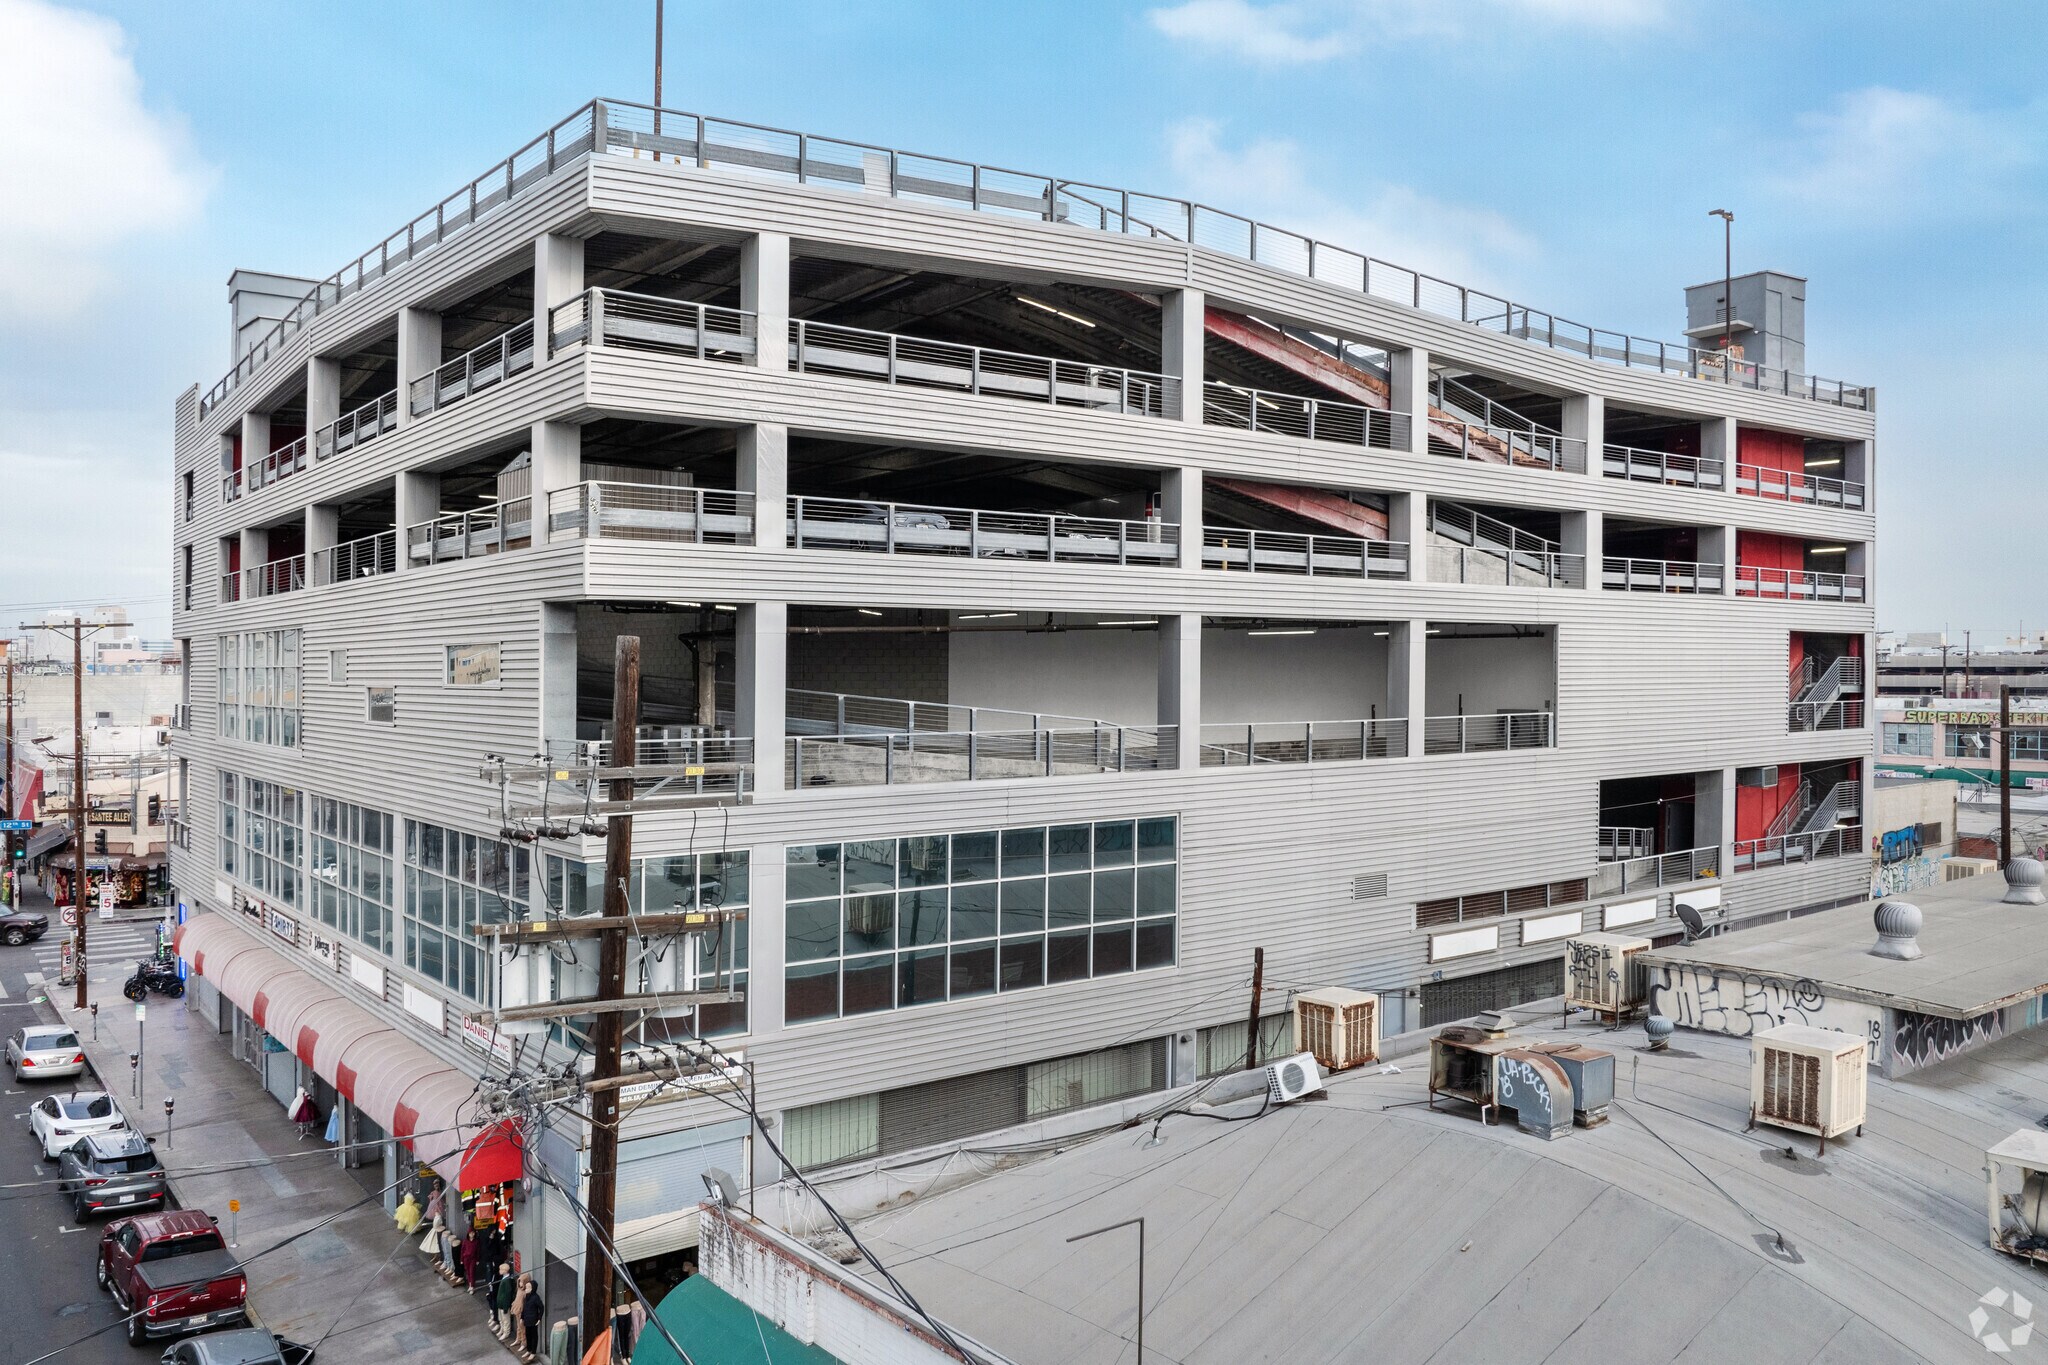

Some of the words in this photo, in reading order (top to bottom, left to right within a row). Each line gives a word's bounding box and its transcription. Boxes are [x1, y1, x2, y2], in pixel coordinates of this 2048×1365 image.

[113, 812, 131, 822] ALLEY
[103, 897, 112, 908] 5
[1867, 1019, 1881, 1040] 18
[1500, 1074, 1514, 1098] 18
